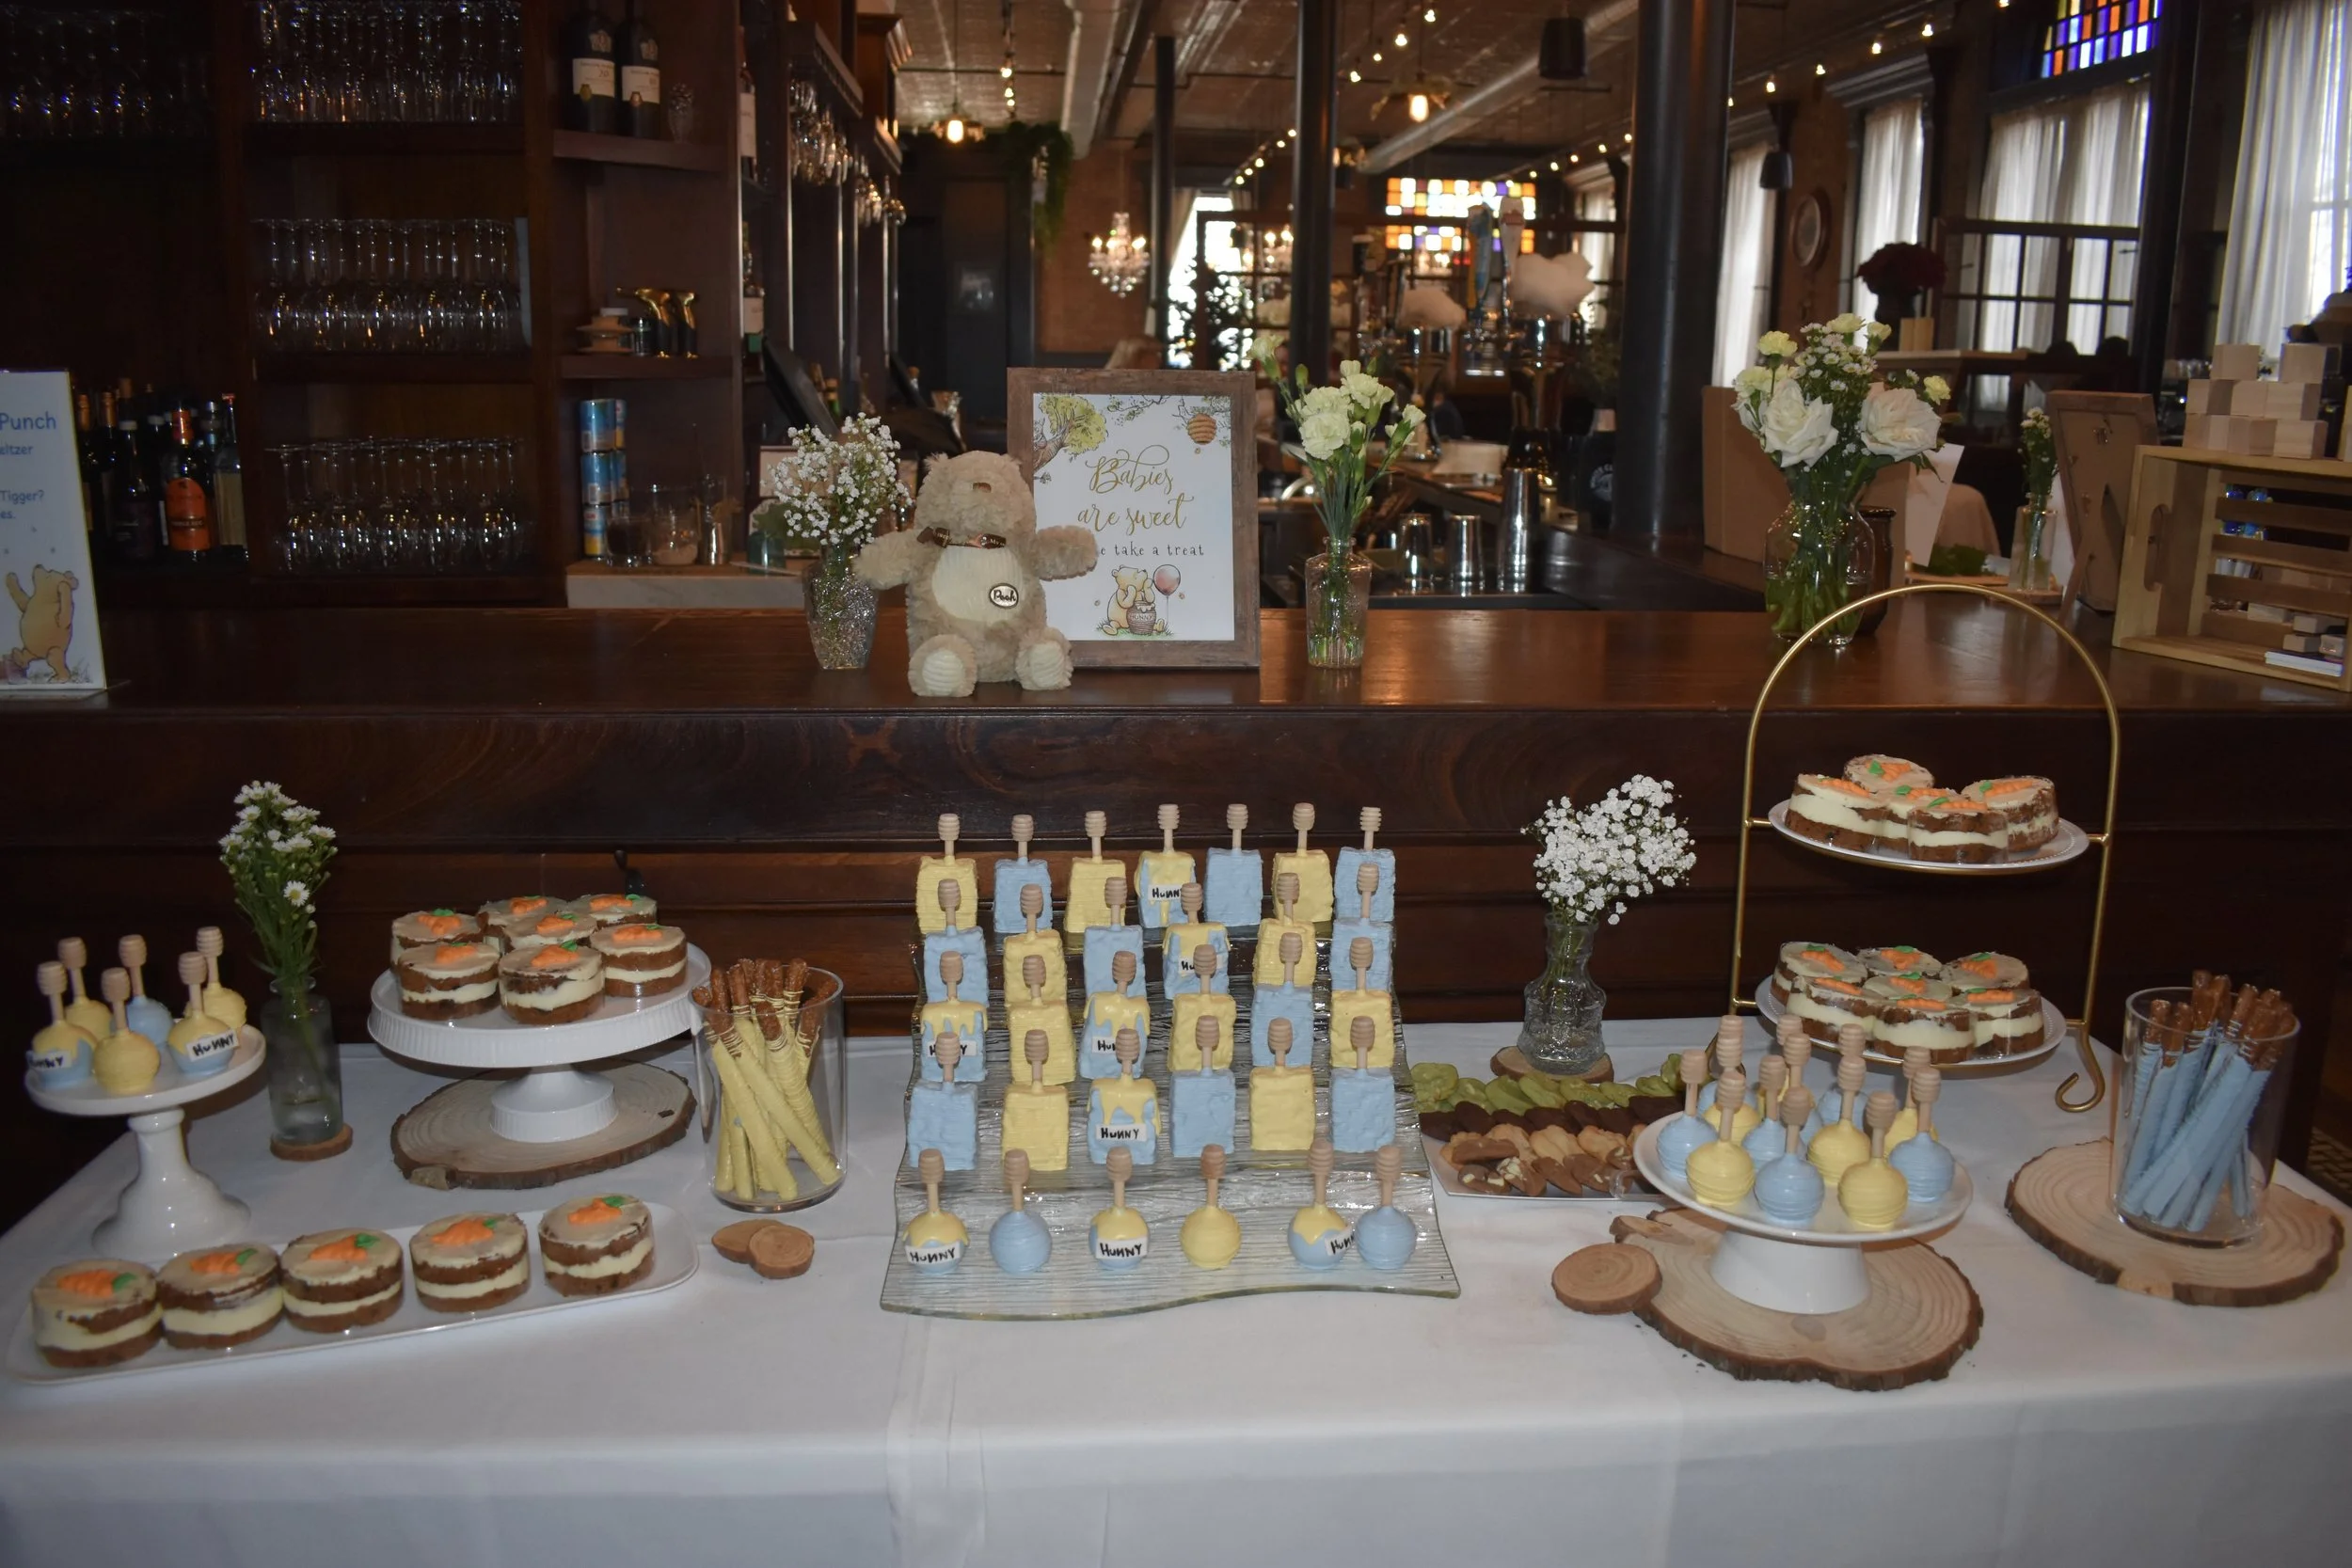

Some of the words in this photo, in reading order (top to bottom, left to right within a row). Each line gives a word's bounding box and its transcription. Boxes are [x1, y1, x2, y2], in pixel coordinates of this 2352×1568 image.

[0, 410, 56, 430] Punch
[1085, 444, 1173, 495] Babies
[0, 489, 44, 505] Tigger?
[1077, 503, 1120, 532] are
[1126, 492, 1195, 536] sweet
[1115, 541, 1144, 556] take
[1152, 546, 1159, 556] a
[1167, 544, 1204, 556] treat
[993, 589, 1017, 602] Pooh
